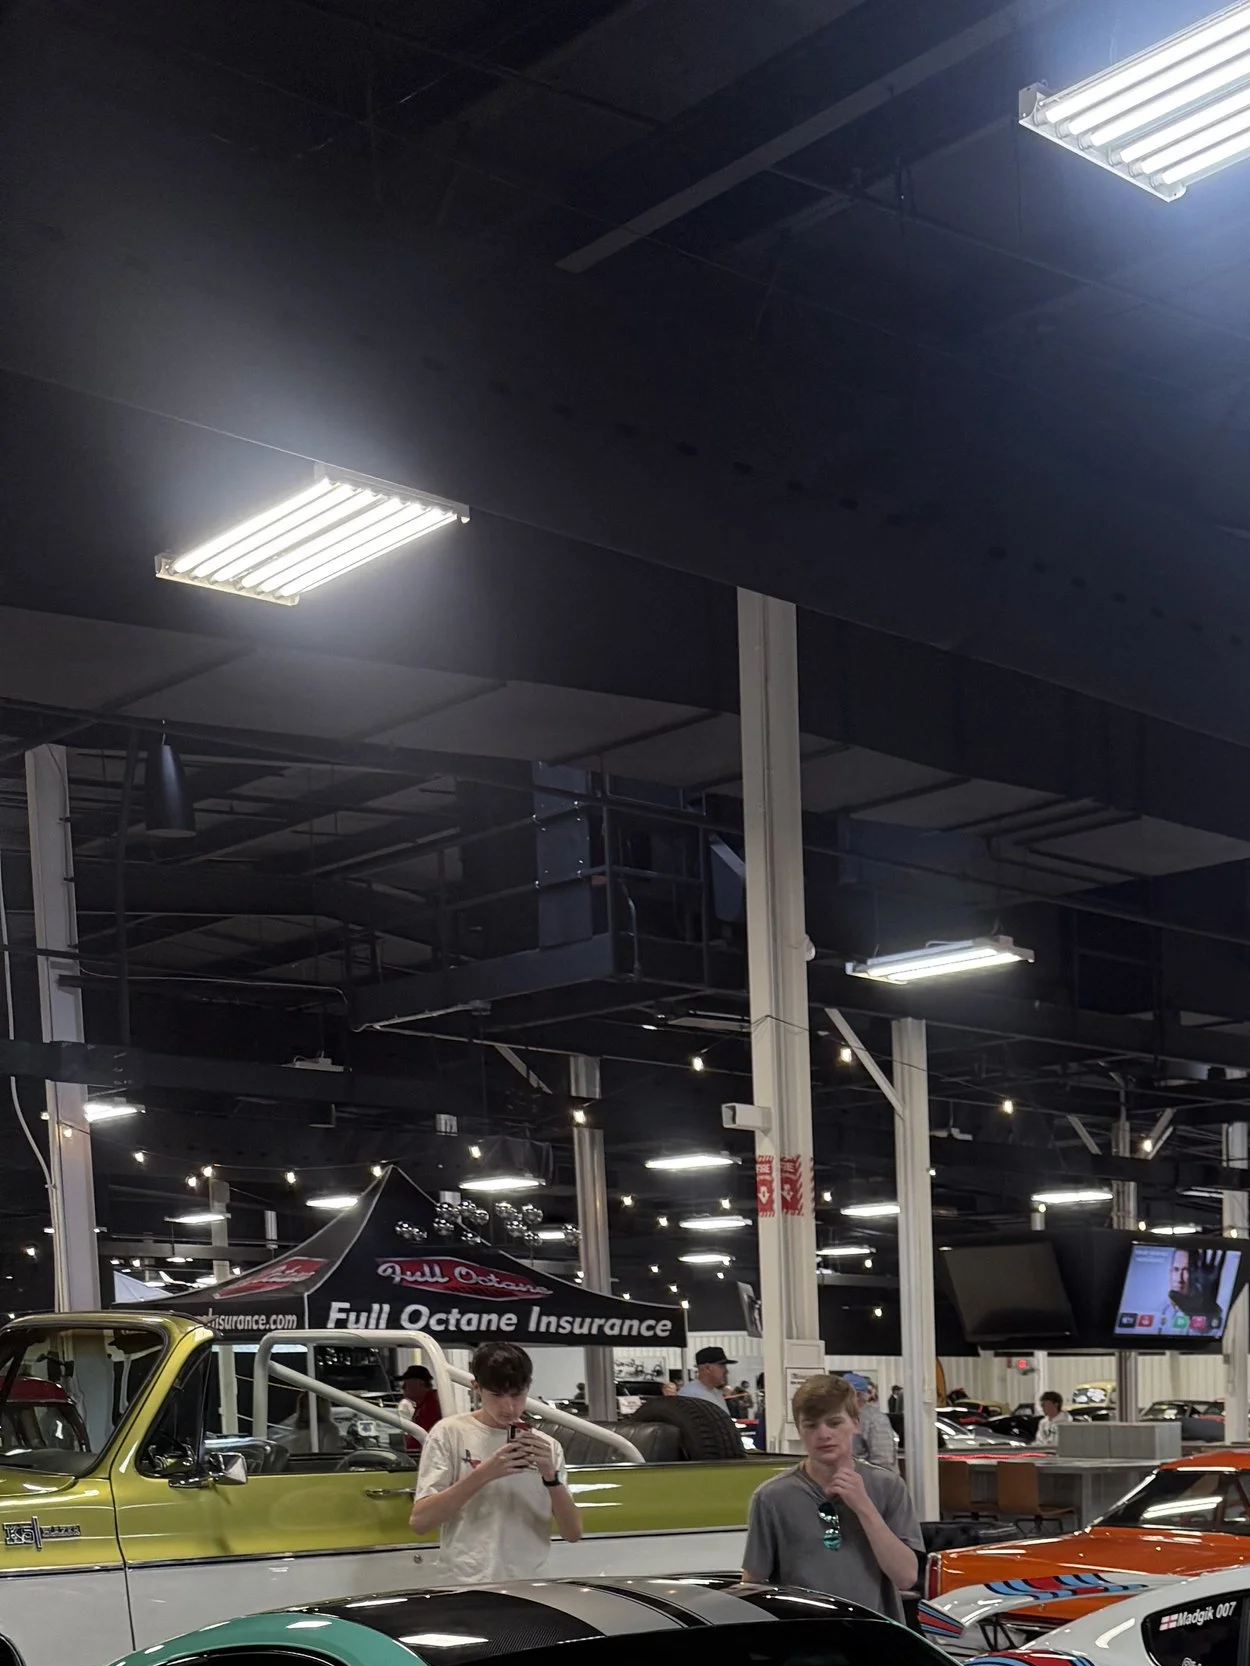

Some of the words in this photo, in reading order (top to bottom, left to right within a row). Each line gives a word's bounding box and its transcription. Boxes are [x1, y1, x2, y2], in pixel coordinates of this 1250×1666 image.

[376, 1261, 449, 1286] Full
[453, 1266, 554, 1296] Octane
[326, 1301, 391, 1330] Full
[400, 1306, 518, 1332] Octane
[528, 1306, 673, 1338] Insurance
[1176, 1606, 1215, 1627] Madgik
[1215, 1601, 1238, 1619] 007
